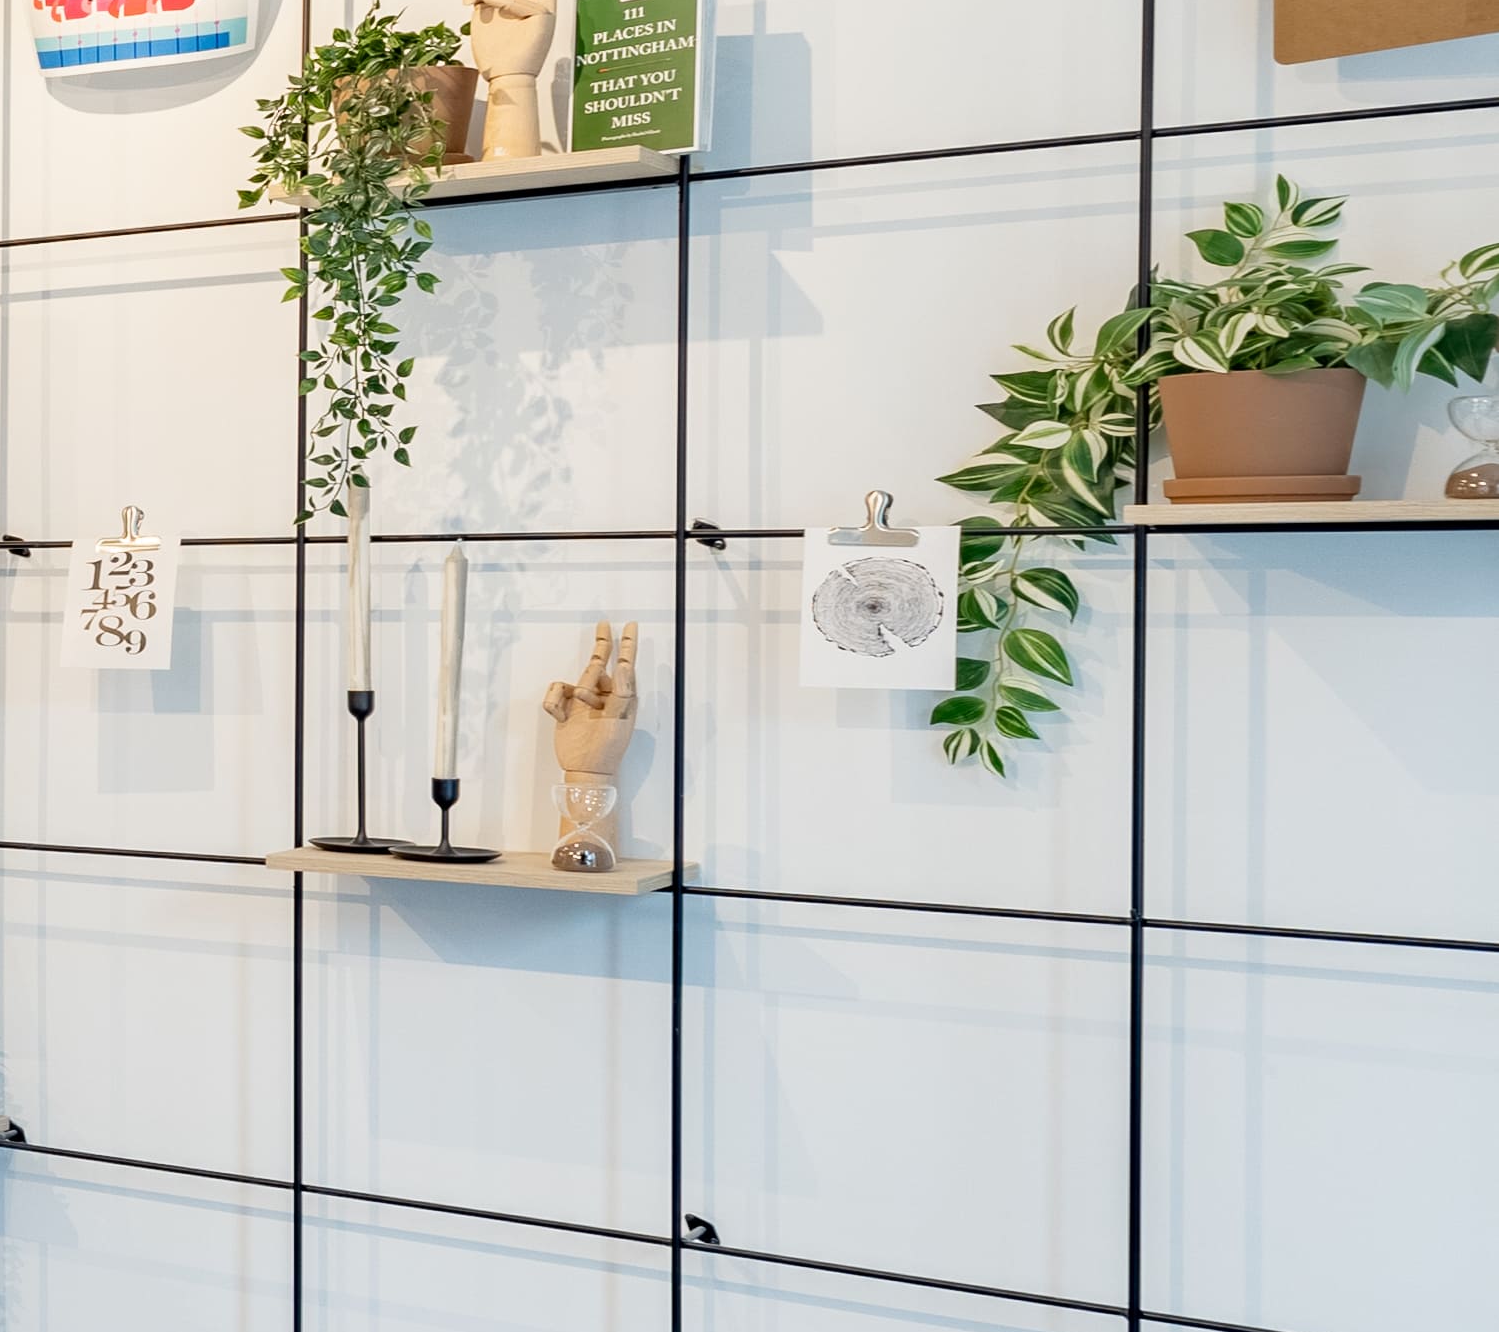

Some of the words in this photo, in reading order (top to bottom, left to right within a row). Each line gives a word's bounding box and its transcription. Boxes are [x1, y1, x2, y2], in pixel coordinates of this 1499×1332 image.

[623, 5, 646, 21] 111
[592, 23, 655, 46] PLACES
[656, 18, 677, 34] IN
[576, 34, 696, 67] NOTTINGHAM
[590, 75, 638, 95] THAT
[640, 68, 677, 86] YOU
[584, 87, 683, 115] SHOULDN'T
[610, 111, 652, 129] MISS
